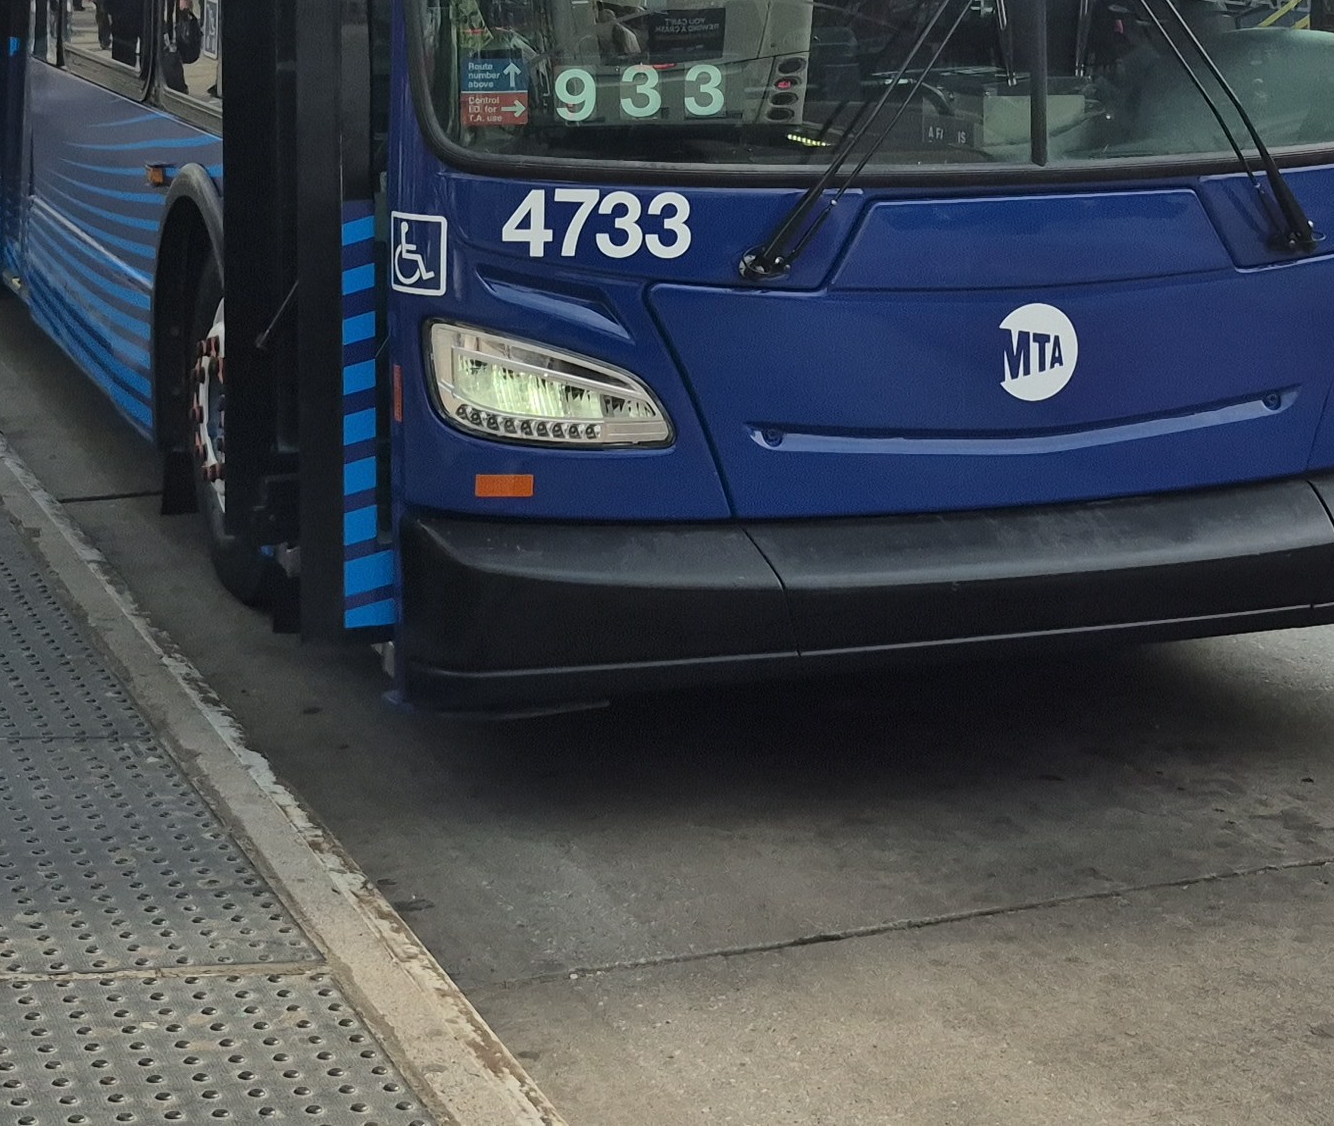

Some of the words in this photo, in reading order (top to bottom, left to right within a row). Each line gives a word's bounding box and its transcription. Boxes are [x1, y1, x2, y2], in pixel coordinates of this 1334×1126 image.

[468, 62, 493, 70] Route
[502, 188, 692, 260] 4733
[1000, 327, 1064, 381] MTA
